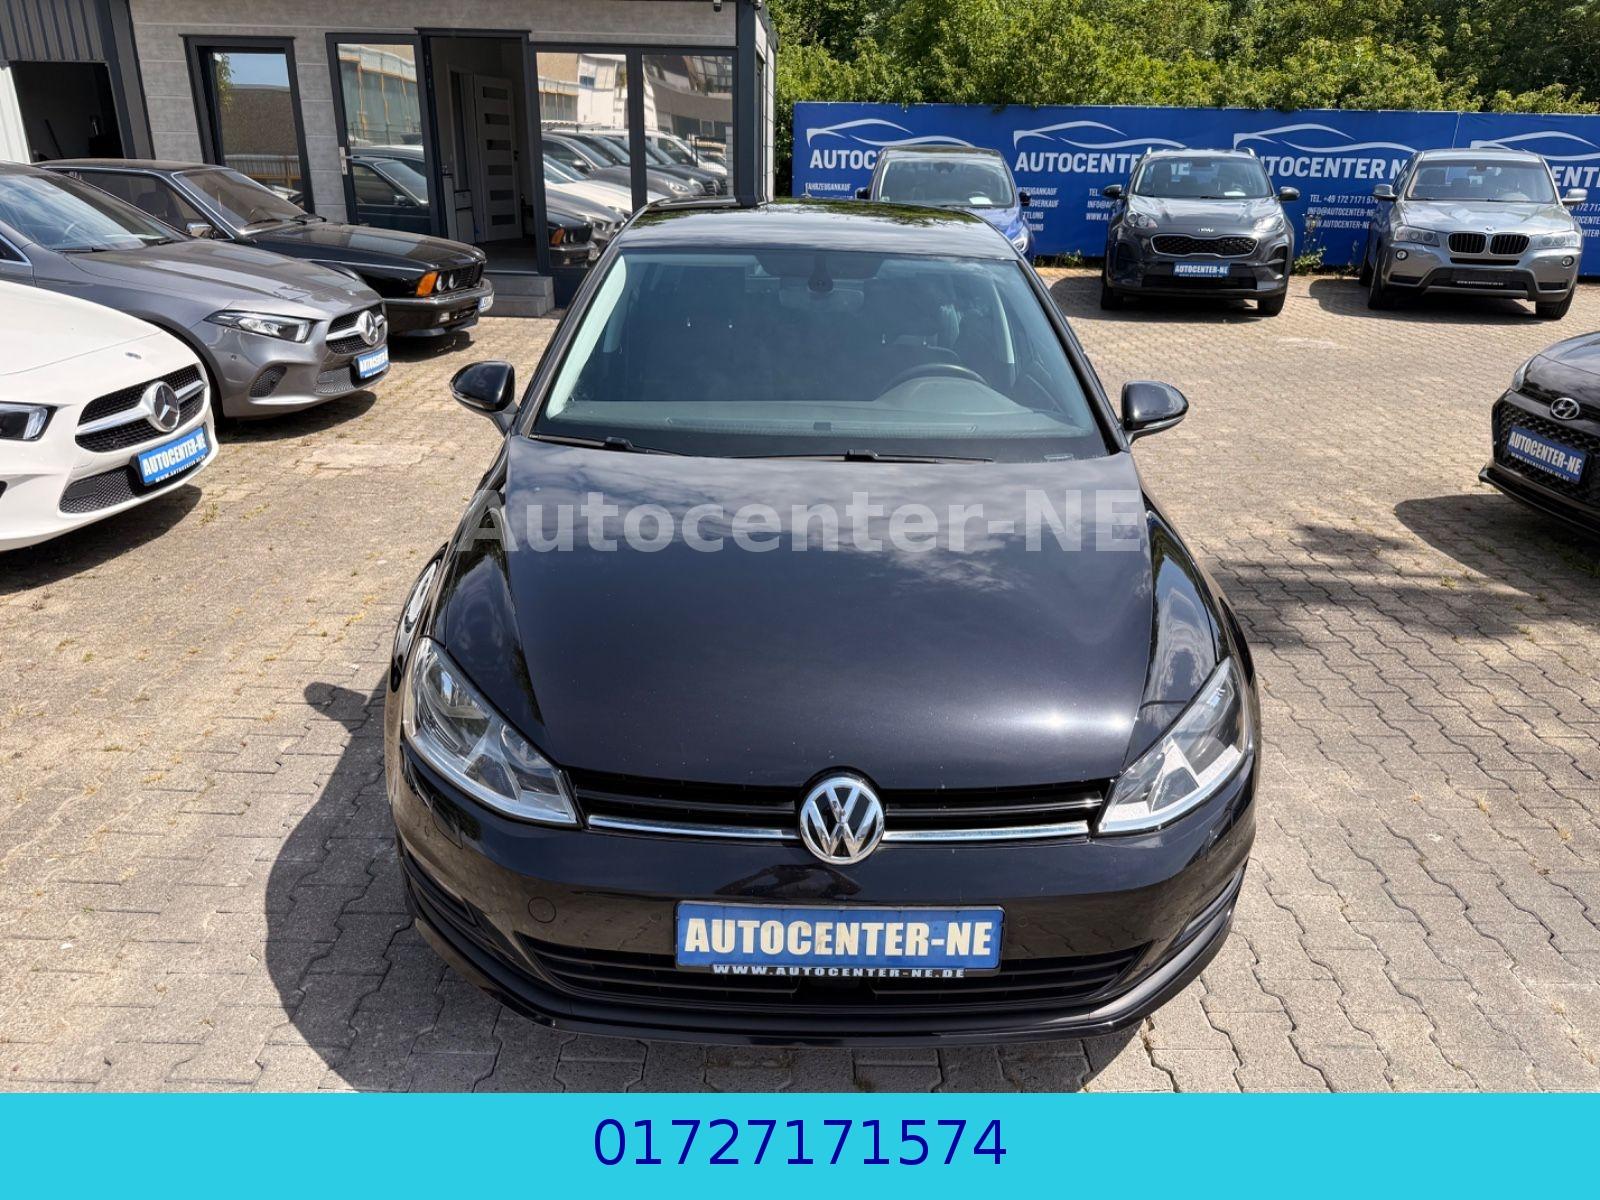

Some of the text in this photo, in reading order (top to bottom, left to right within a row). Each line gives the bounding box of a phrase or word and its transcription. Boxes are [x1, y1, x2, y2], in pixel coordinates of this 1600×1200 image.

[809, 149, 881, 170] AUTOC
[1551, 165, 1600, 188] ENT
[142, 432, 207, 477] AUTOCENTER-NE
[1508, 431, 1582, 475] AUTOCENTER-NE
[684, 918, 993, 956] AUTOCENTER-NE
[713, 964, 965, 978] WWW.AUTOCENTER-NE.DE
